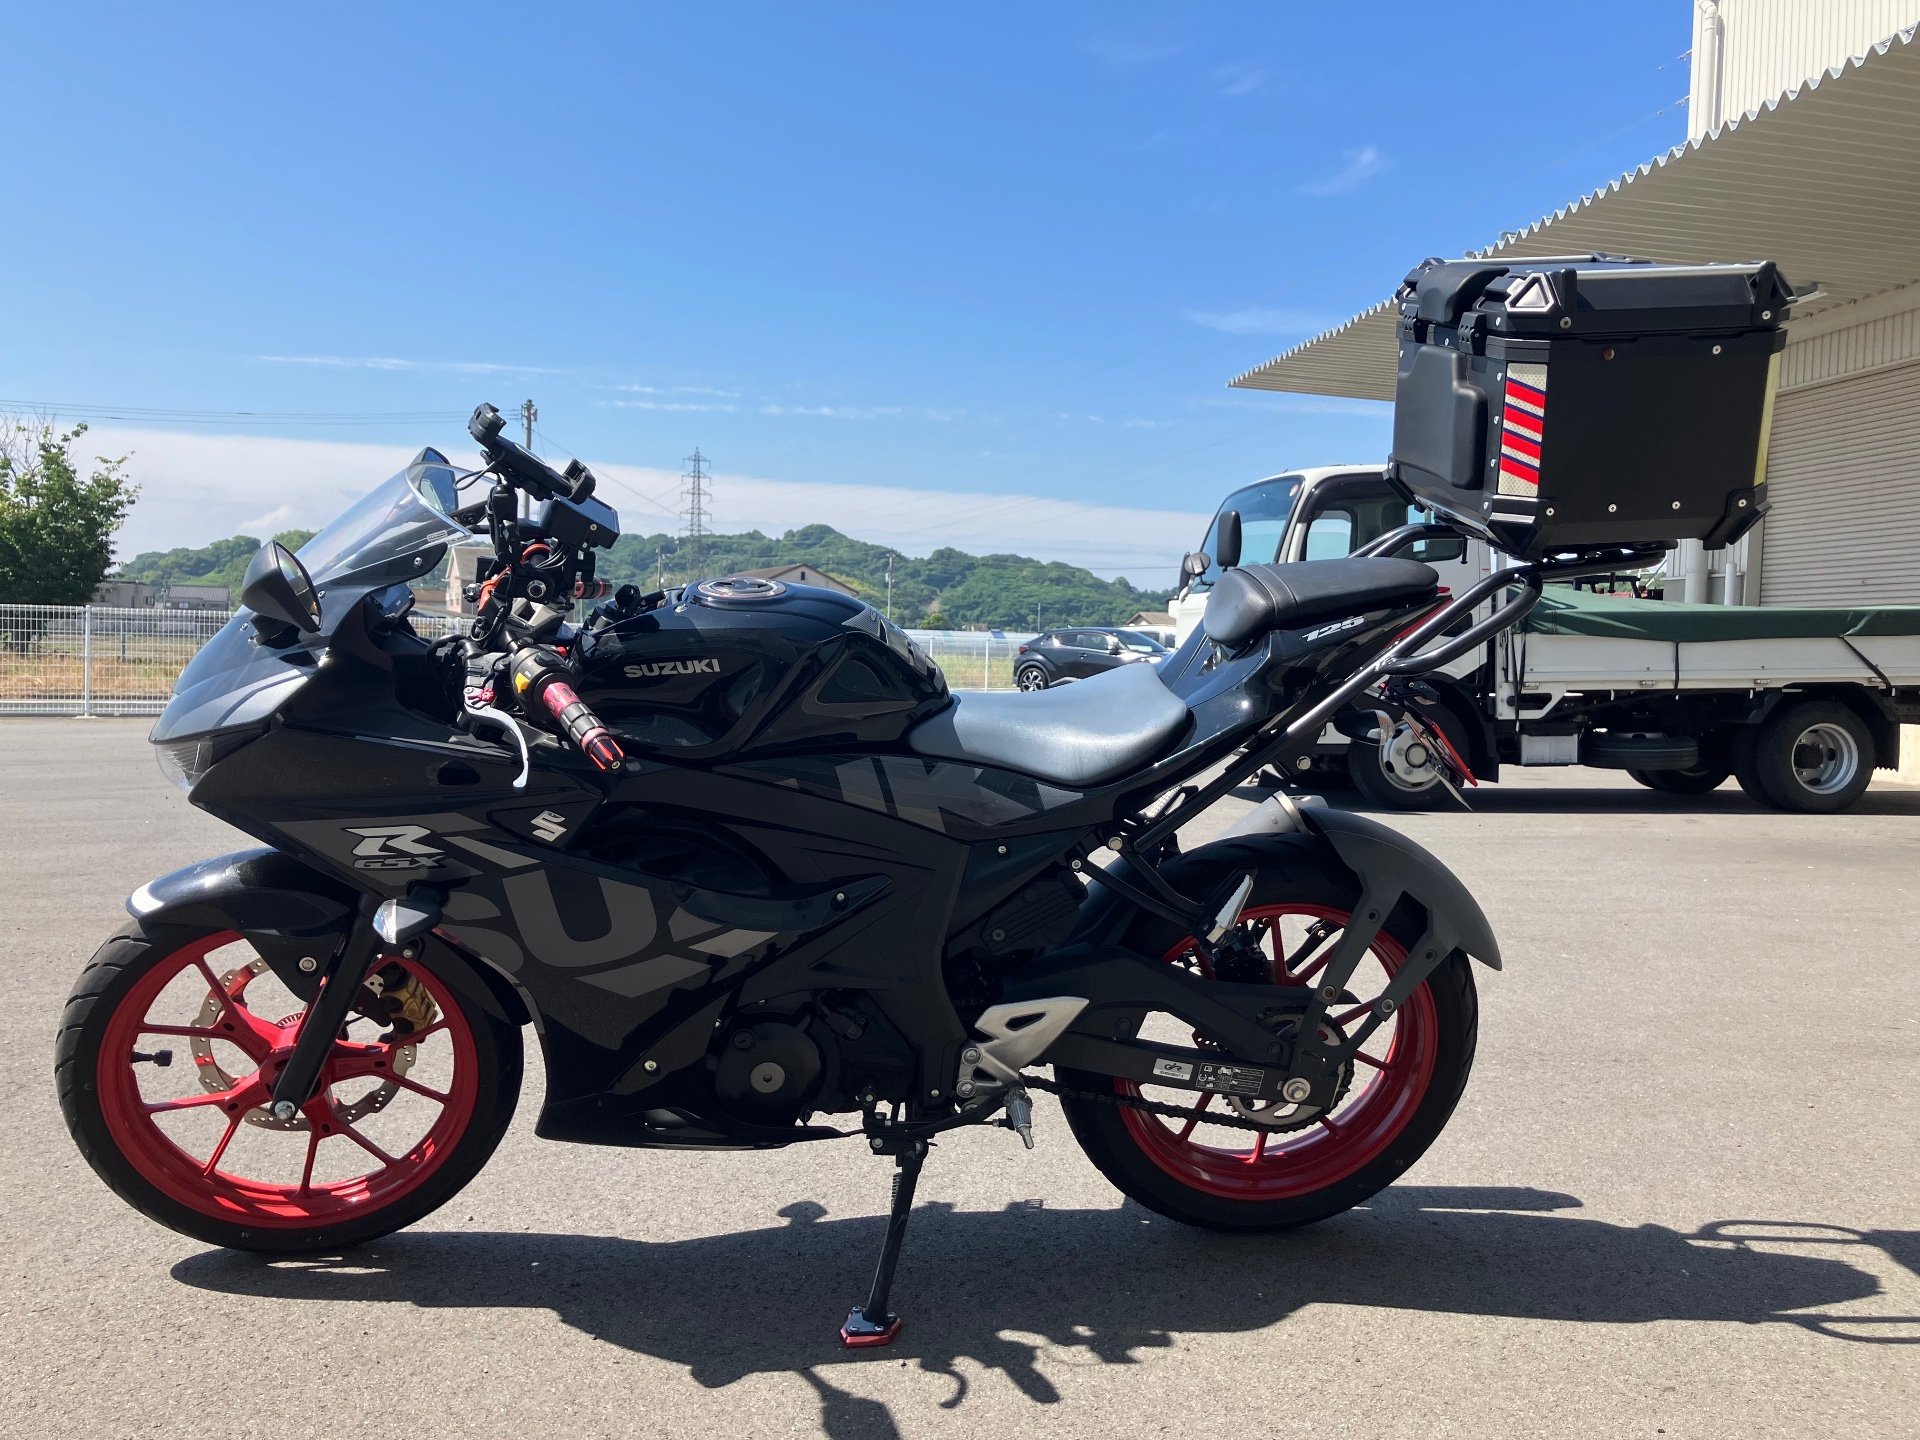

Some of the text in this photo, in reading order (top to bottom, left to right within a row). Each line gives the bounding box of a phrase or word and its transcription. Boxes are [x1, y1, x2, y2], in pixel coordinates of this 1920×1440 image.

[1303, 616, 1364, 642] 125
[624, 659, 721, 678] SUZUKI
[343, 825, 446, 857] R
[353, 855, 446, 870] GSX
